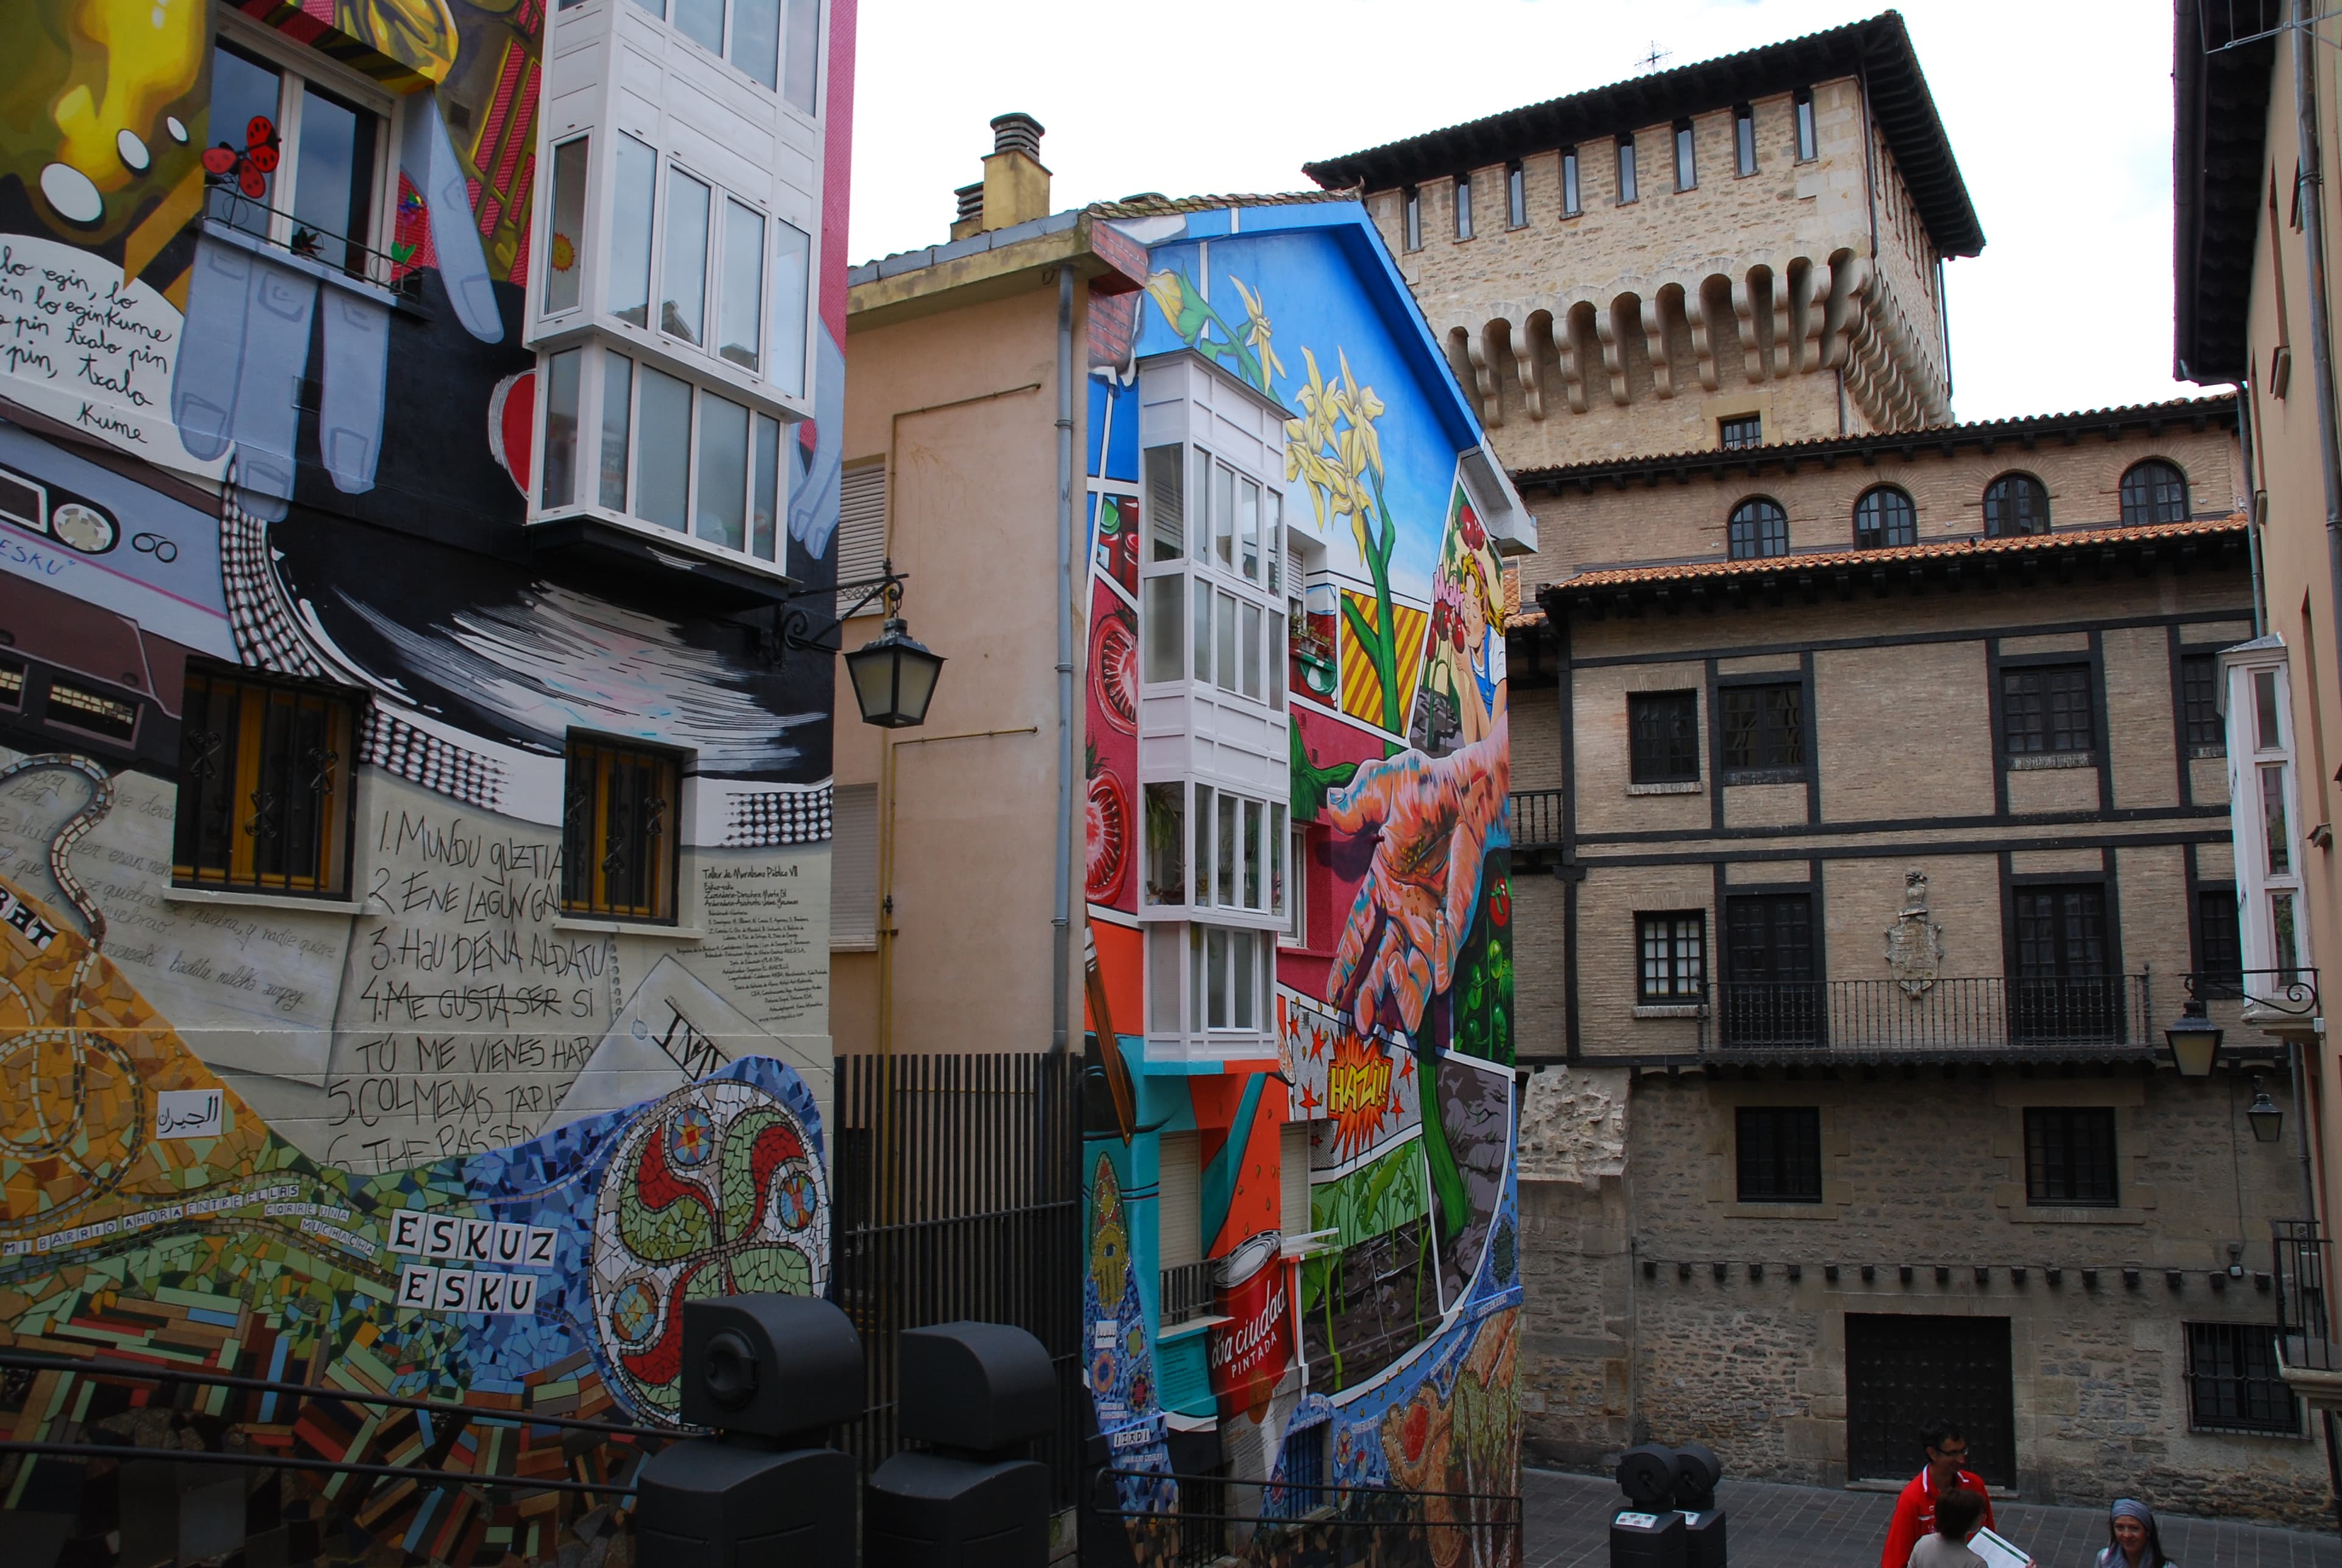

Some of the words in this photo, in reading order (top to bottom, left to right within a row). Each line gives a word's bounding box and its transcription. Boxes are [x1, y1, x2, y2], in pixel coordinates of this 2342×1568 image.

[35, 286, 61, 313] lo
[105, 281, 138, 308] lo
[15, 316, 49, 337] pin
[65, 322, 122, 353] txalo
[129, 345, 167, 374] pin
[79, 353, 153, 406] txalo
[395, 811, 481, 868] MUNDU
[401, 871, 459, 912] ENE
[451, 931, 524, 978] DENA
[531, 932, 608, 983] ALDATU
[417, 1036, 456, 1072] ME
[158, 1096, 218, 1133] الجيران
[358, 1077, 493, 1127] COLMENAS
[4, 1242, 26, 1253] MI
[39, 1223, 115, 1248] BARRIO
[125, 1206, 181, 1226] AHORA
[188, 1198, 240, 1213] ENTRE
[248, 1185, 298, 1203] ELLAS
[265, 1203, 313, 1215] CORRE
[320, 1205, 348, 1220] UNA
[302, 1219, 373, 1253] MUCHACHA
[395, 1215, 554, 1261] ESKUZ
[405, 1271, 532, 1311] ESKU
[1231, 1331, 1278, 1378] PINTADA
[1115, 1432, 1147, 1445] IZADI
